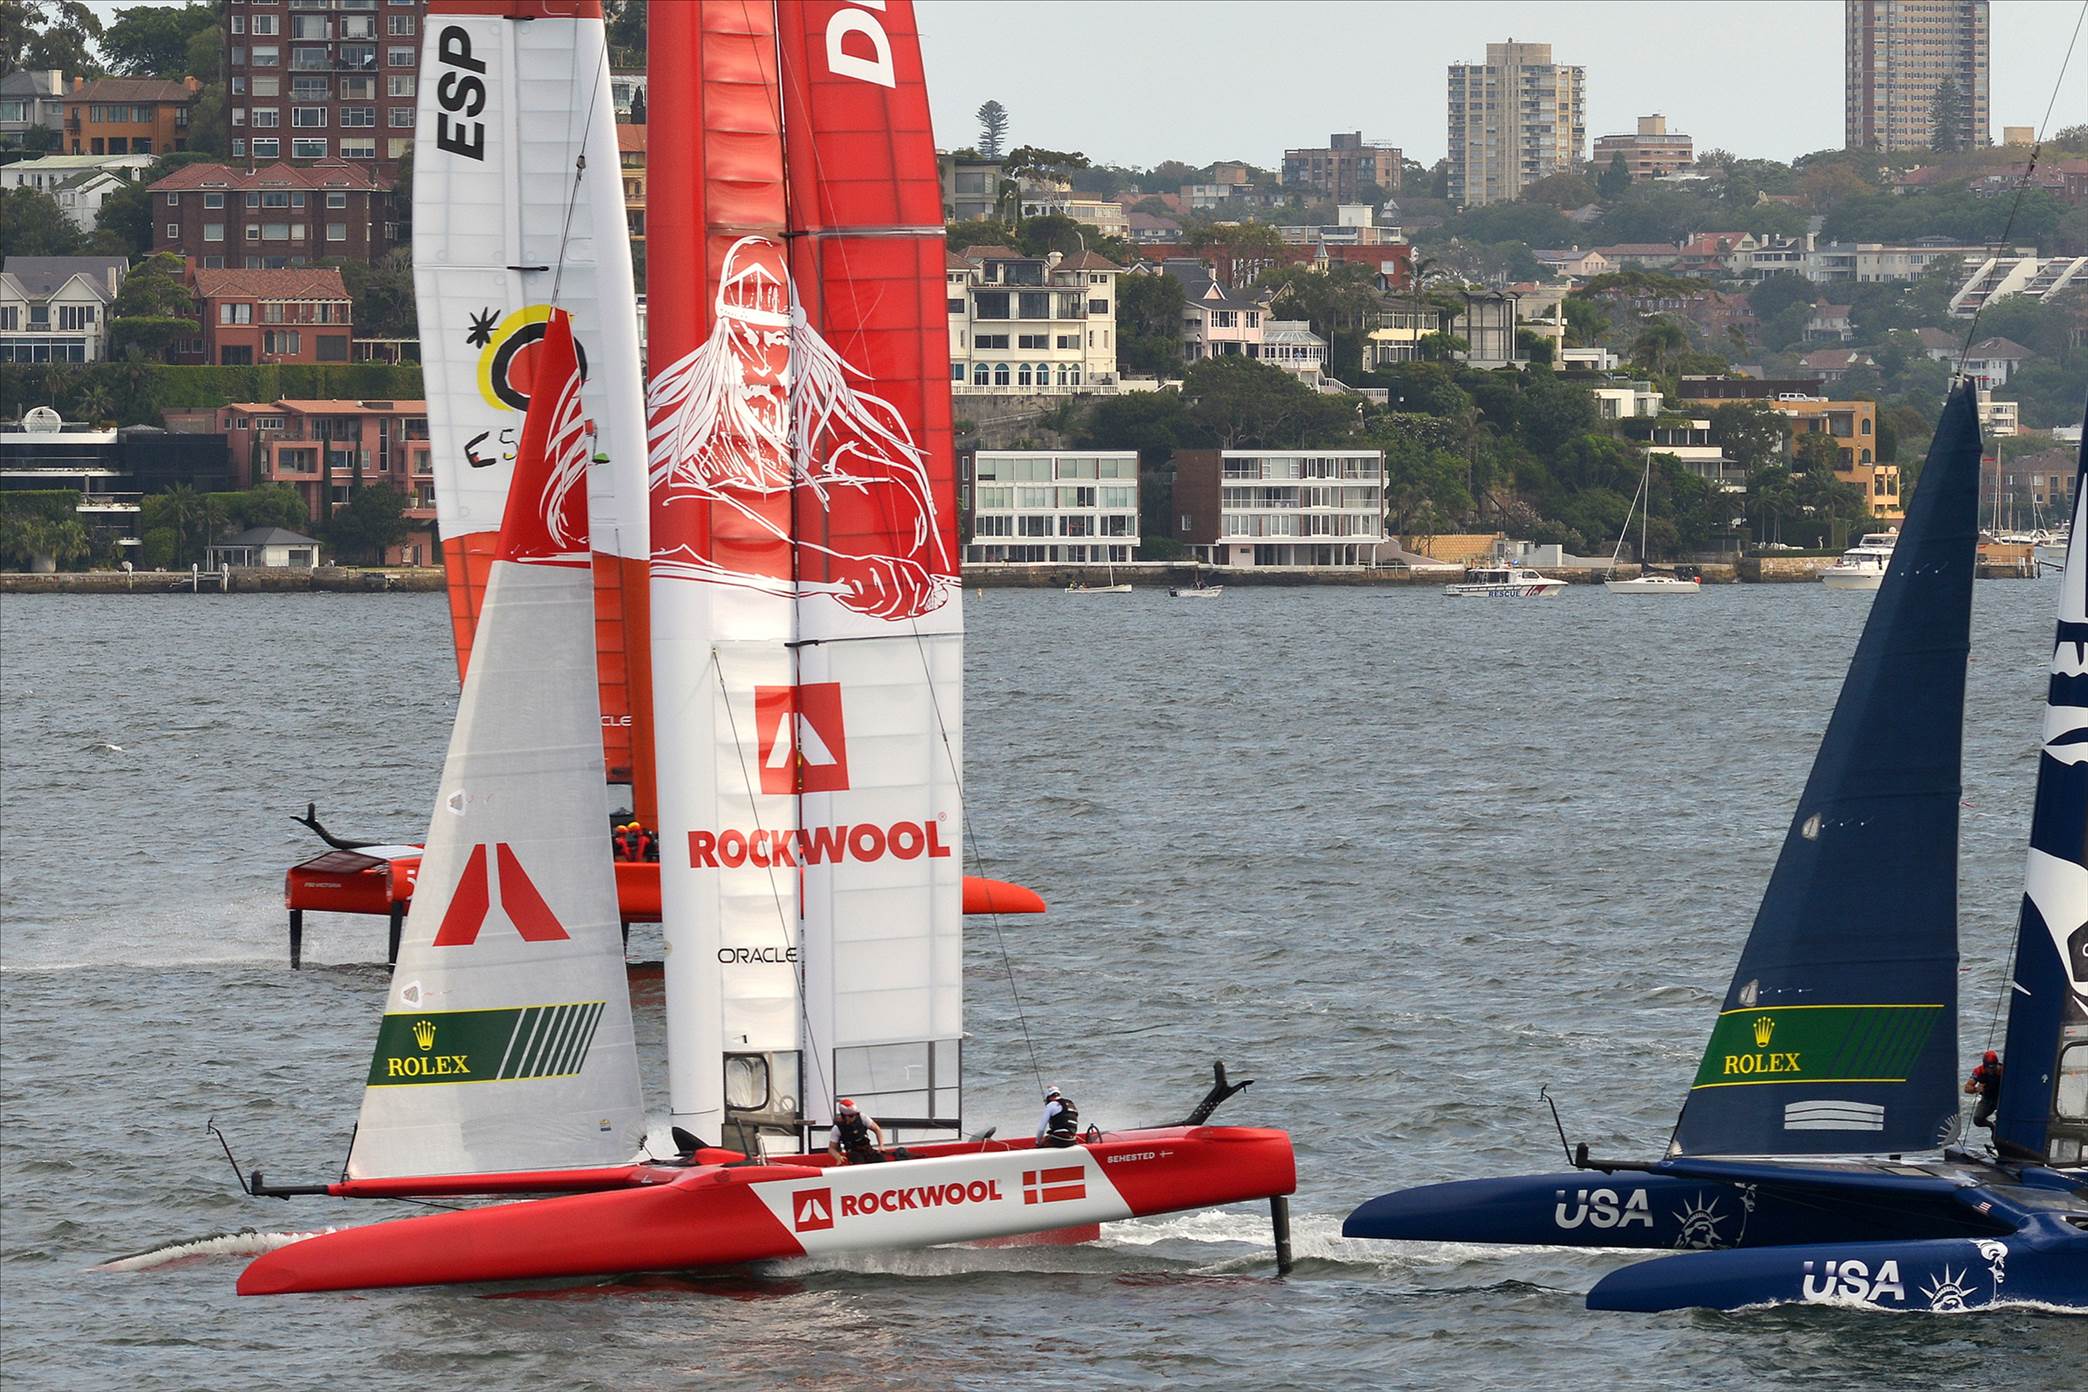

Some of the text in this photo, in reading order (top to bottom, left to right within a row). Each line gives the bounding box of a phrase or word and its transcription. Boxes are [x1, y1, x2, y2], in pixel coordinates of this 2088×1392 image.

[825, 0, 896, 89] D
[437, 25, 486, 161] ESP
[1488, 590, 1520, 598] RESCUE
[688, 820, 951, 869] ROCKWOOL
[717, 946, 798, 964] ORACLE
[387, 1055, 471, 1077] ROLEX
[1723, 1053, 1801, 1075] ROLEX
[1106, 1151, 1156, 1163] SEHESTED
[840, 1179, 1002, 1217] ROCKWOOL
[1554, 1188, 1654, 1229] USA
[1802, 1259, 1905, 1302] USA
